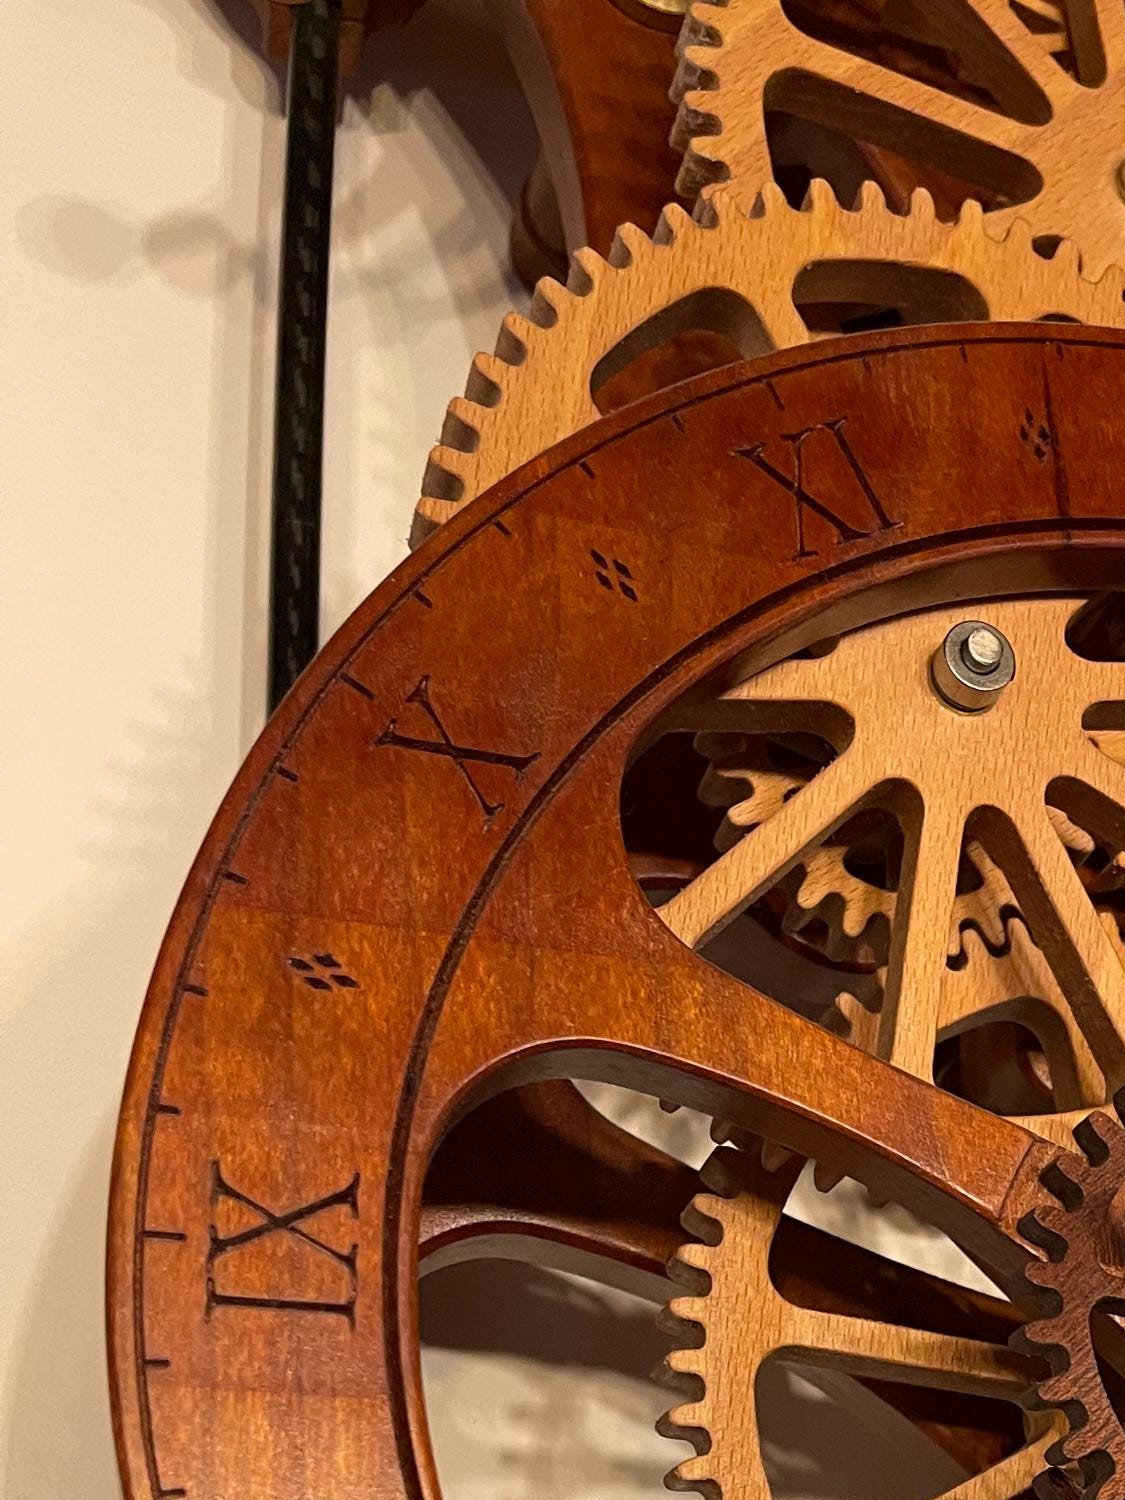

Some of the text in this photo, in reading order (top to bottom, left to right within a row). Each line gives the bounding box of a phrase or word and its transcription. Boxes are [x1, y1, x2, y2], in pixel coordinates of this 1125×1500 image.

[728, 416, 904, 562] XI
[373, 674, 542, 832] X
[204, 1160, 360, 1331] IX
